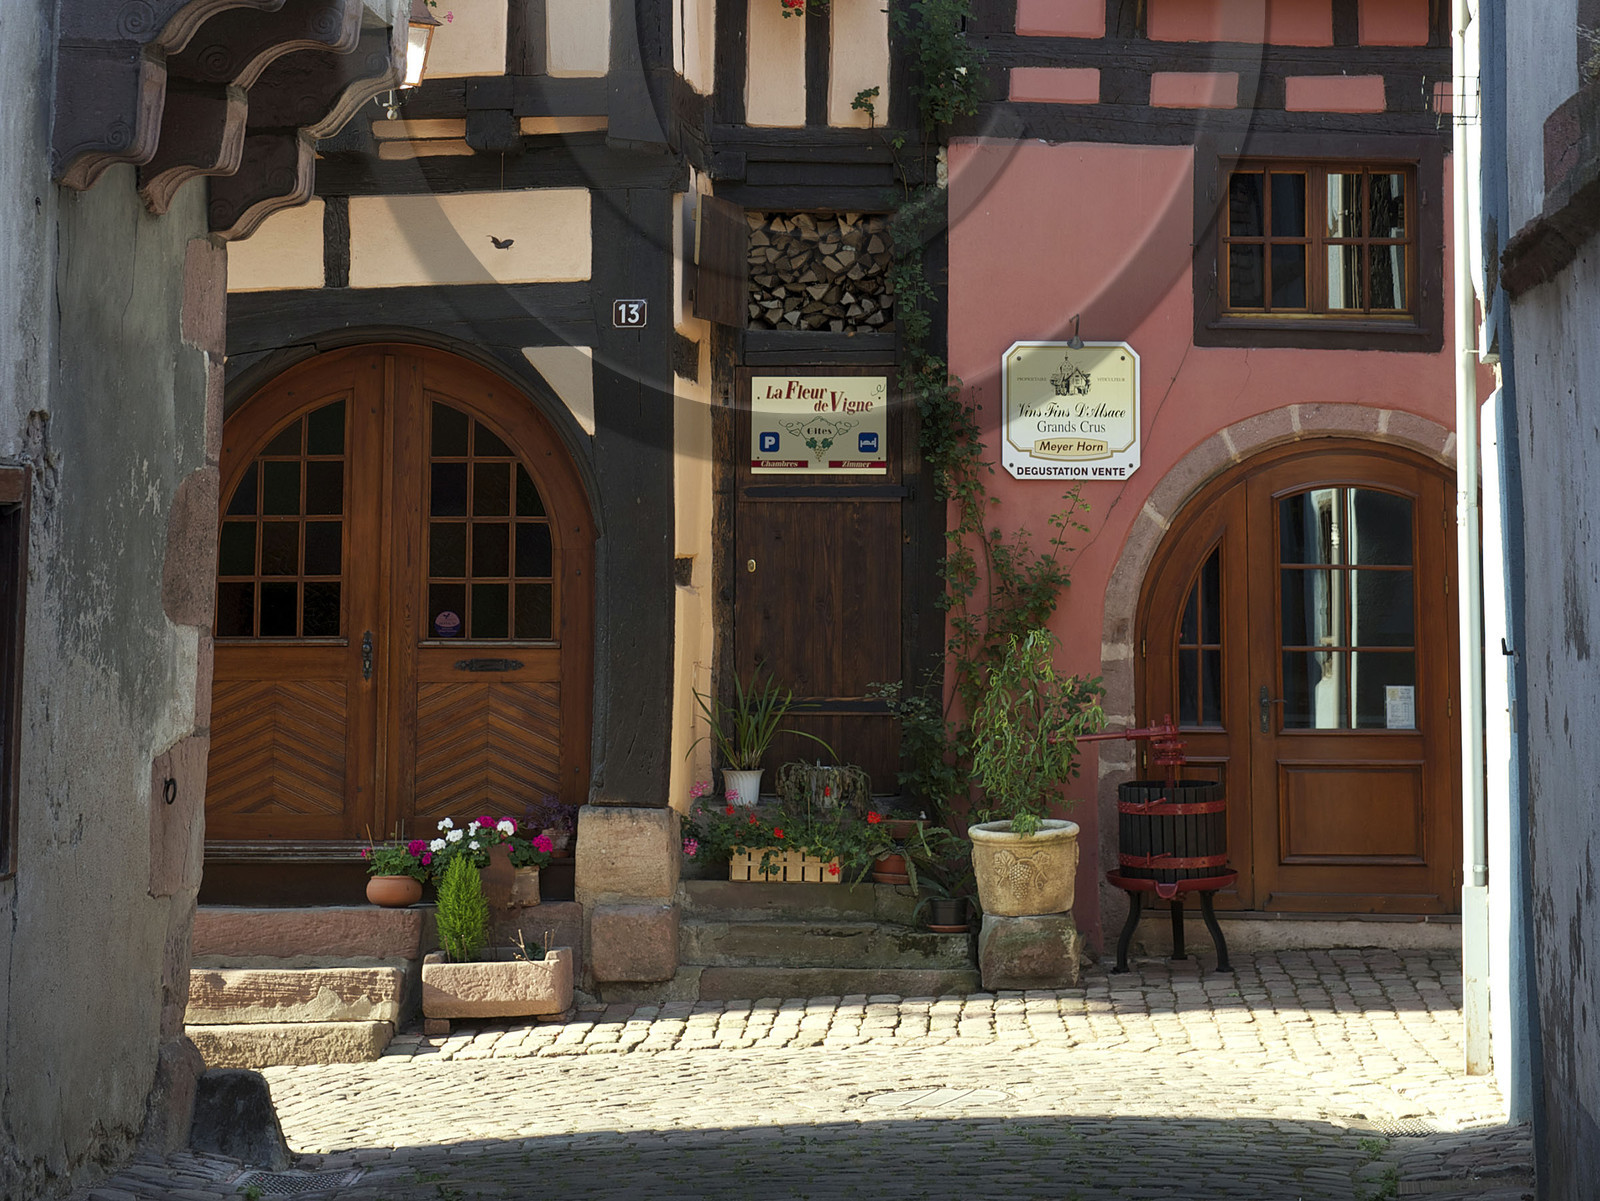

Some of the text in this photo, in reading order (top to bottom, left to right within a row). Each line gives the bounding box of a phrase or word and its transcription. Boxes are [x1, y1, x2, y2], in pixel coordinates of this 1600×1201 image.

[618, 303, 640, 324] 13
[766, 380, 827, 400] La Fleur
[813, 391, 874, 415] de Vigne
[1018, 402, 1126, 418] Vins Fins D'Alsace
[1037, 420, 1106, 433] Grands Crus
[1039, 441, 1104, 453] Meyer Horn
[760, 460, 799, 468] Chambres
[841, 460, 871, 468] Zimmer
[1016, 466, 1126, 476] DEGUSTATION VENTE
